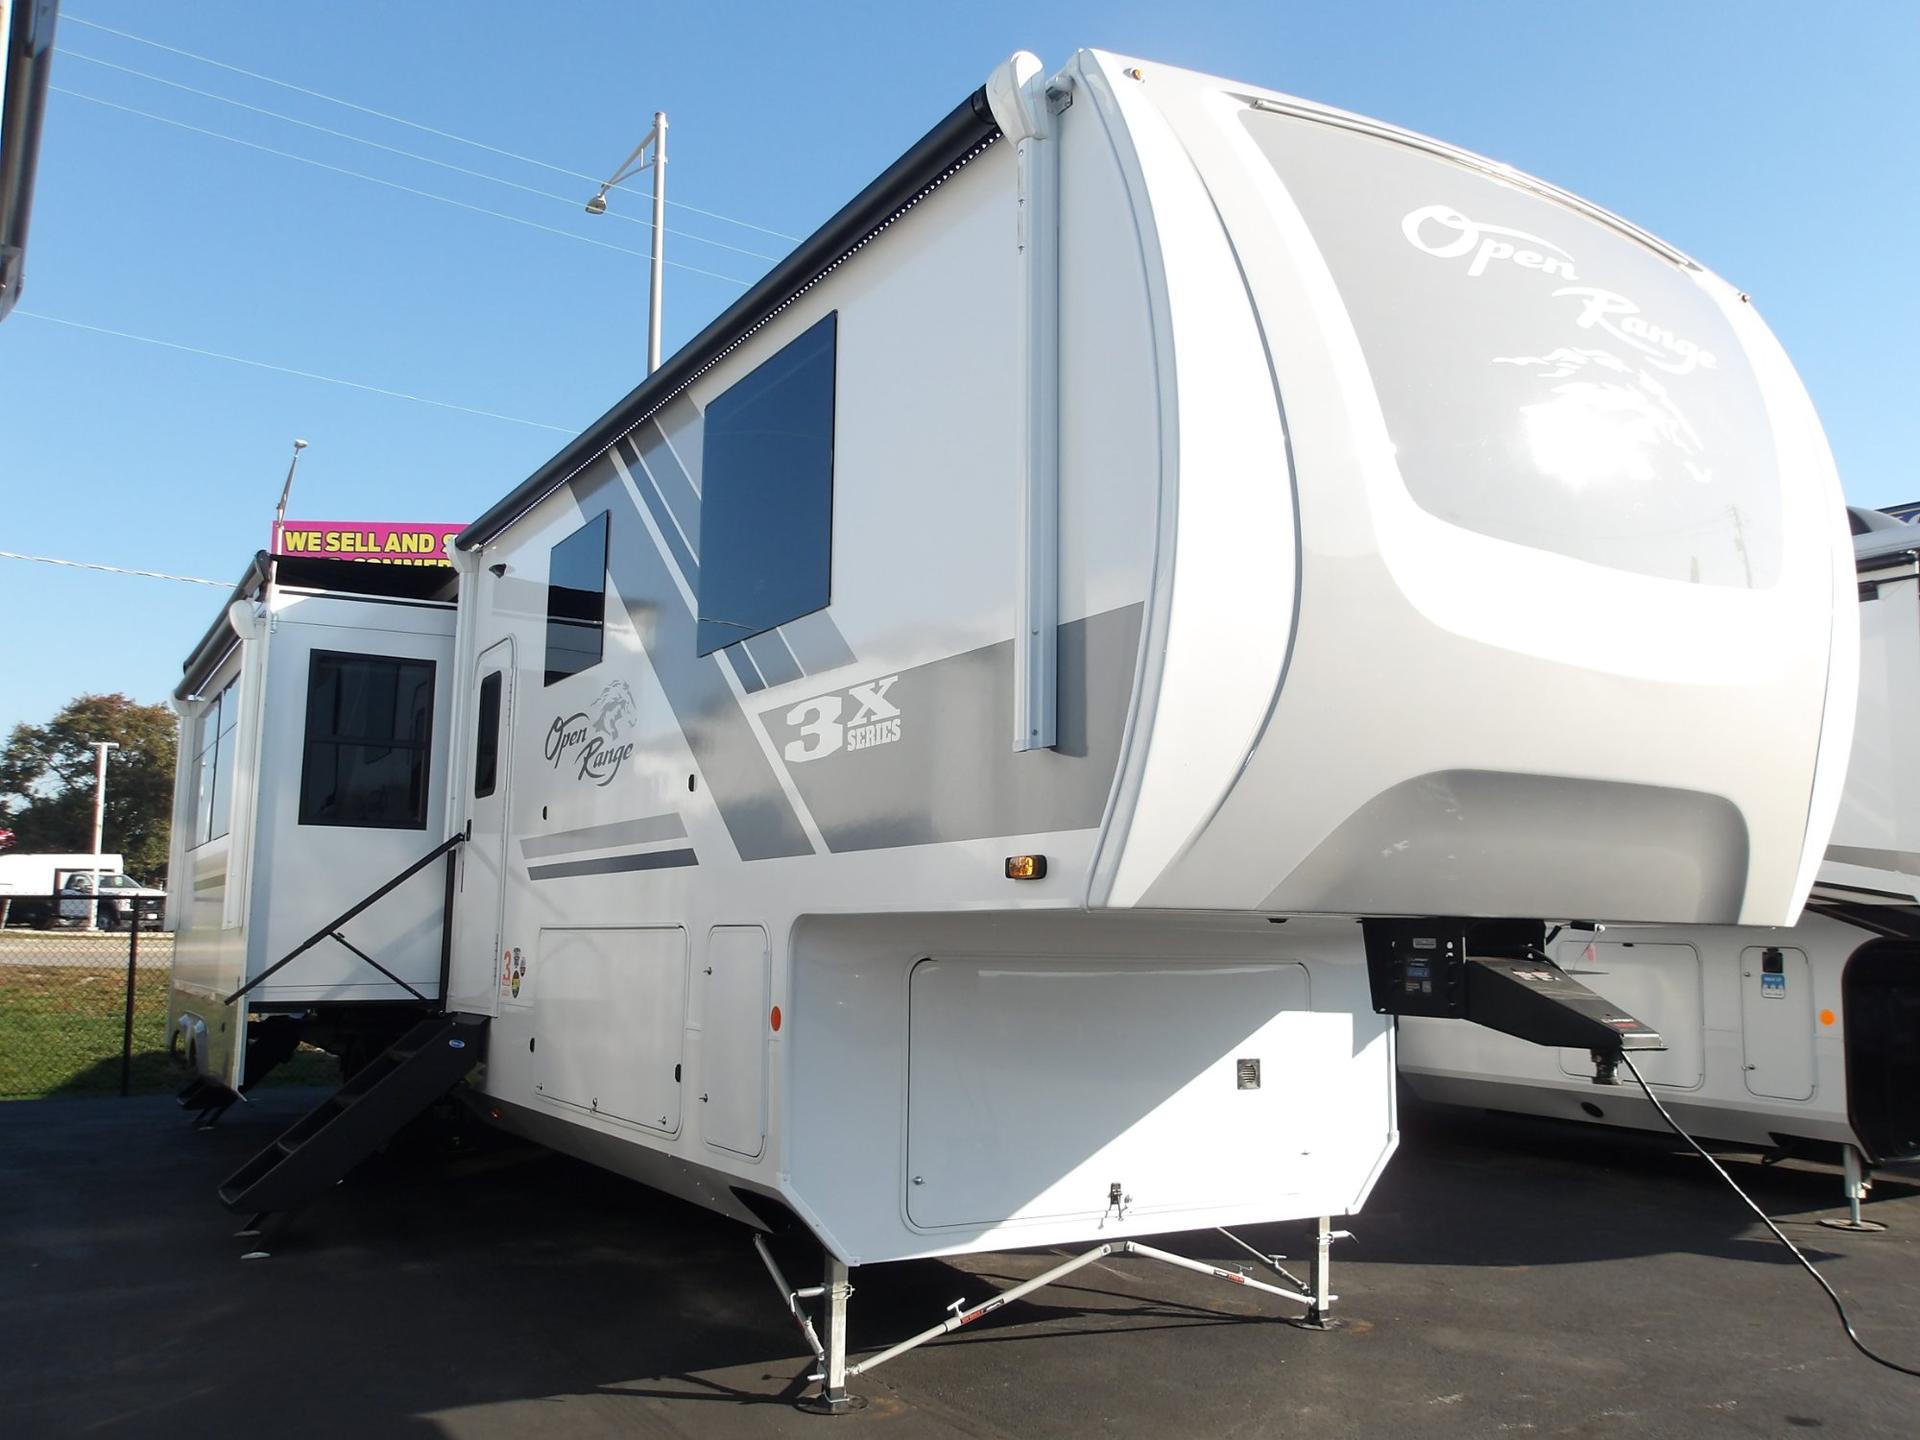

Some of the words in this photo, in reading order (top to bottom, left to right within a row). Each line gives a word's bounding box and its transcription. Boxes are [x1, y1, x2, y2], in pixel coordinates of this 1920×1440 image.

[1401, 205, 1580, 281] Open
[1552, 286, 1718, 376] Range
[285, 530, 323, 552] WE
[325, 531, 382, 553] SELL
[383, 532, 436, 554] AND
[544, 711, 590, 769] Open
[573, 736, 634, 788] Range
[847, 718, 902, 752] SERIES
